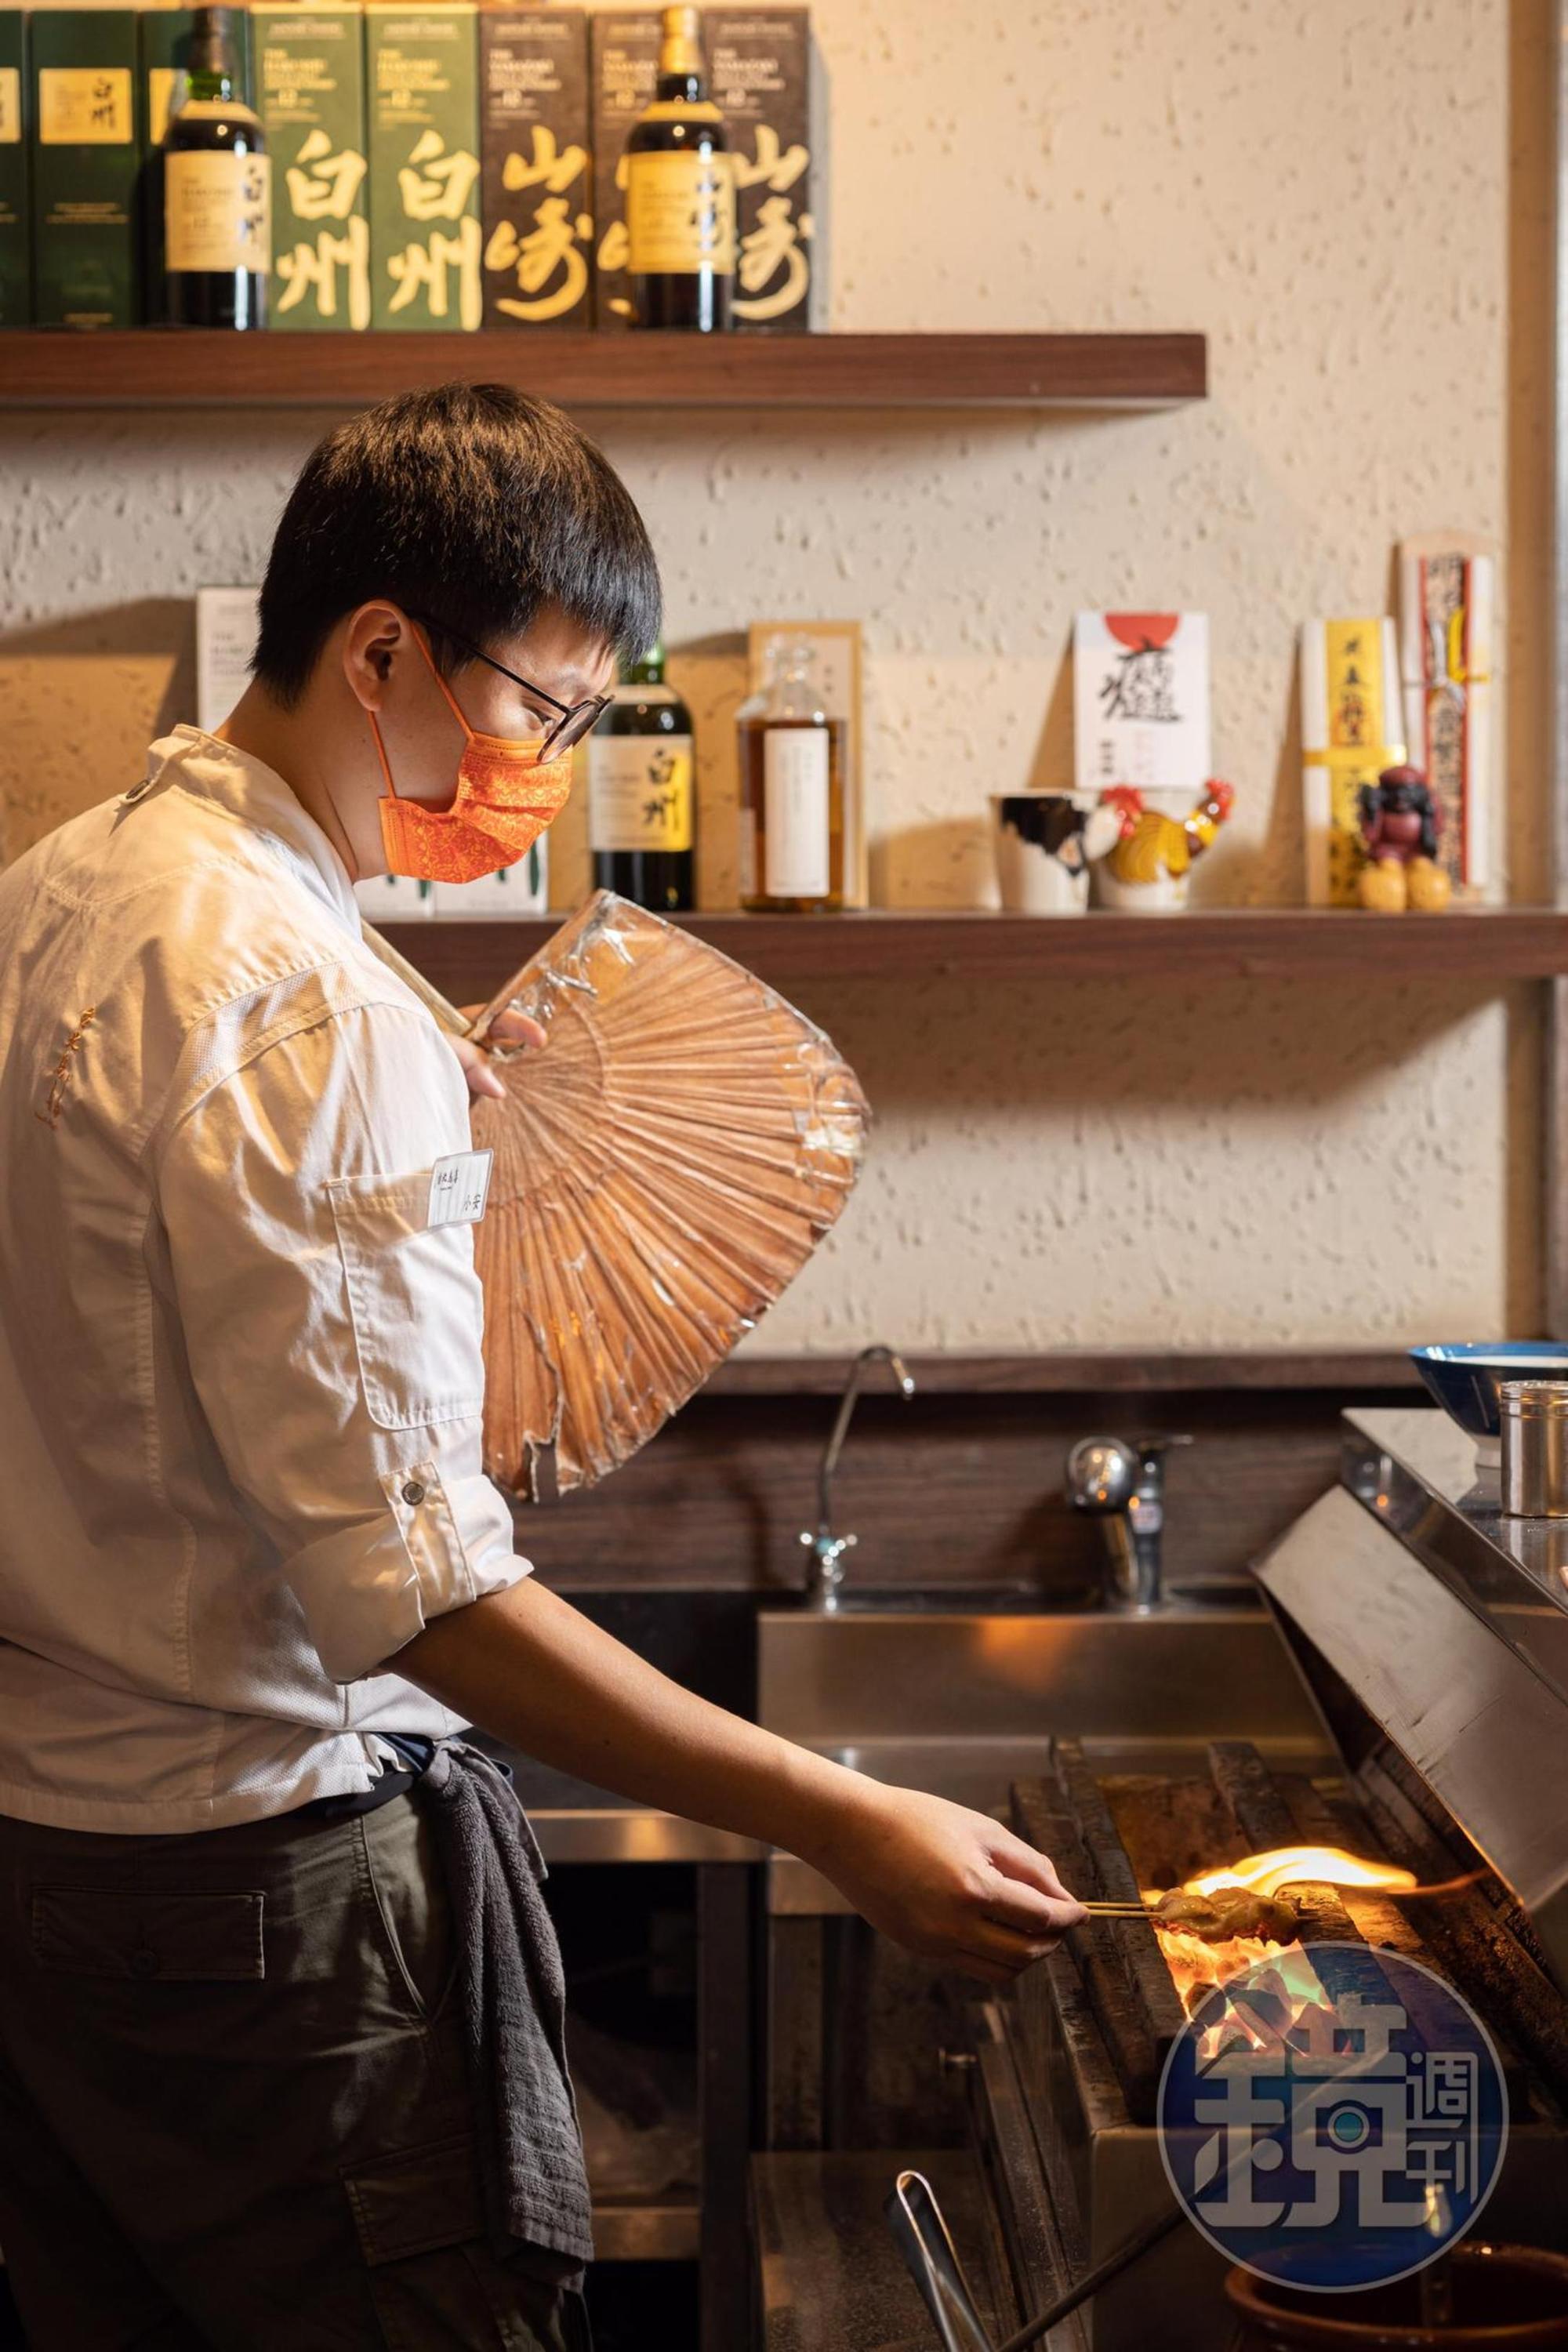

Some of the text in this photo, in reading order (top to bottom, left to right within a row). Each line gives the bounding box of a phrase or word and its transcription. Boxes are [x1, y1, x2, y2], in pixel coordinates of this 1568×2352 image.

[276, 129, 370, 331] 白州
[388, 129, 482, 331] 白州
[485, 125, 593, 321] 山崎
